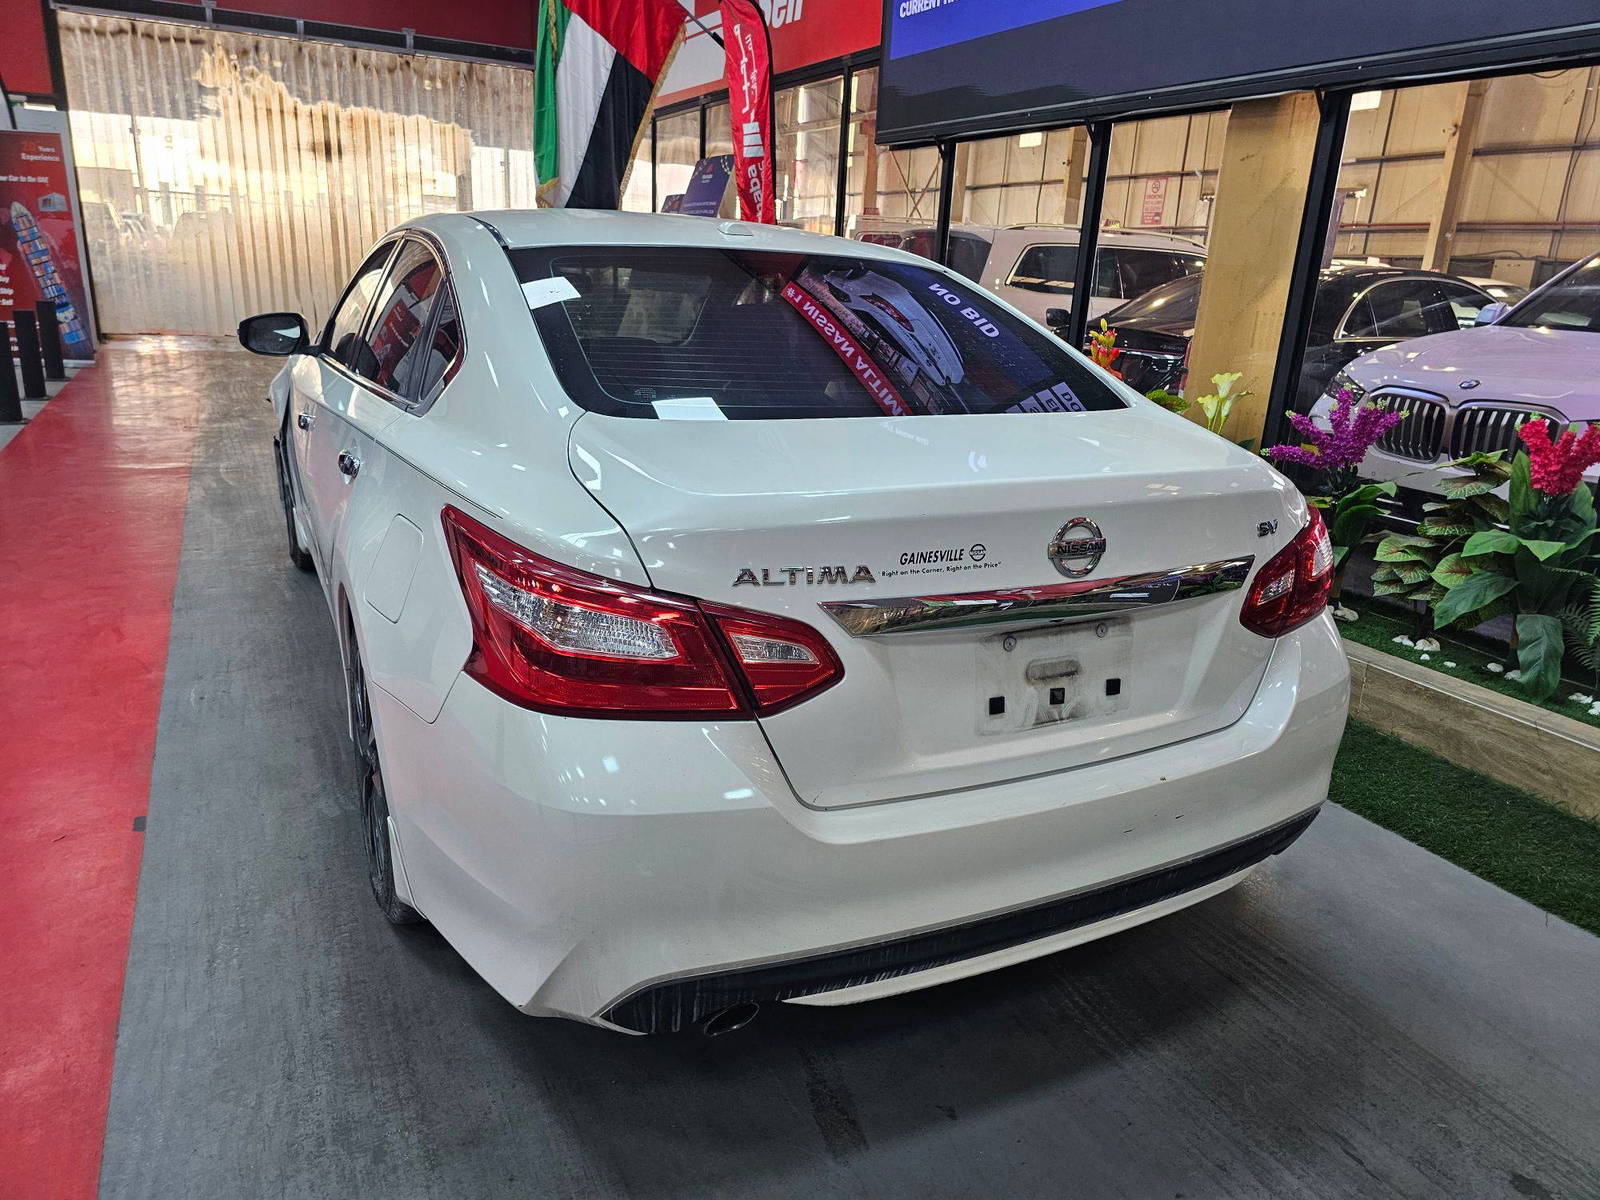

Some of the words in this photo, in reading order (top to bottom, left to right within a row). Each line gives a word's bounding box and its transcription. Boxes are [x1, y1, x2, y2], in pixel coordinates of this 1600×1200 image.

[21, 153, 60, 161] Experience
[1256, 519, 1279, 538] SV
[1057, 538, 1105, 554] NISSAN
[899, 548, 965, 566] GAINESVILLE
[732, 565, 876, 587] ALTIMA
